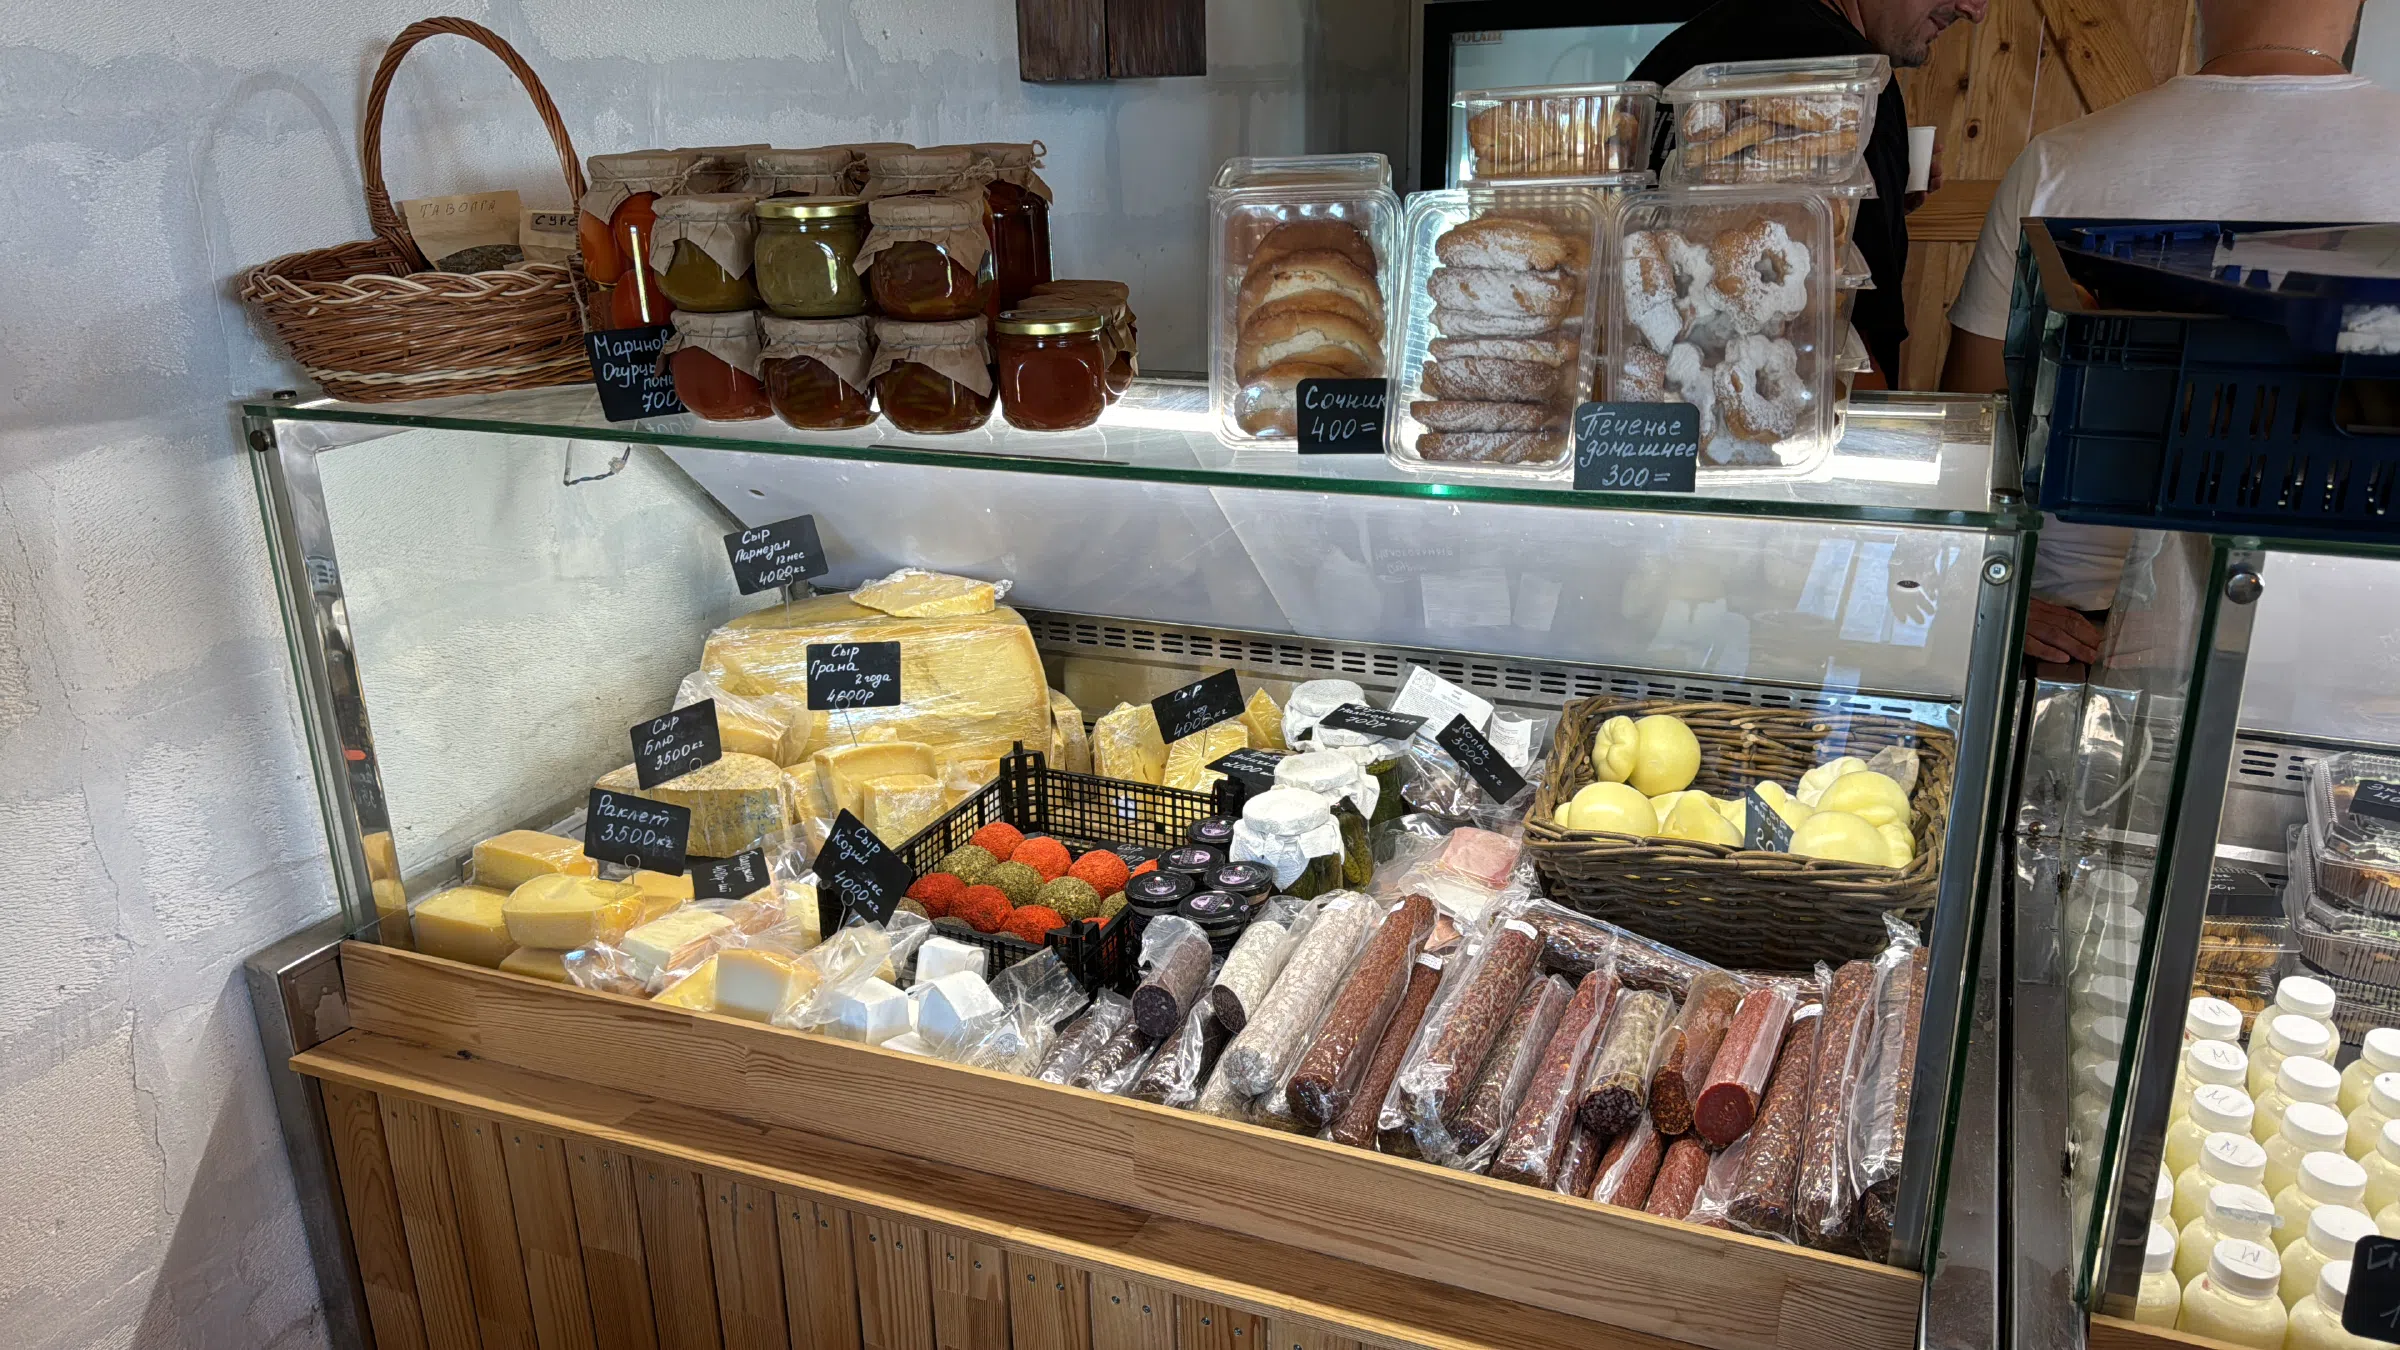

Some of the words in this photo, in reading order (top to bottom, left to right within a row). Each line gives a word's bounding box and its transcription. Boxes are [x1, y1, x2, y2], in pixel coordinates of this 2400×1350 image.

[641, 389, 684, 413] 700
[1576, 405, 1682, 441] Печенье
[1579, 440, 1697, 468] домашнее
[742, 529, 771, 544] Сыр
[831, 643, 860, 662] Сыр
[810, 659, 860, 681] Грана
[1174, 684, 1203, 702] Сыр
[652, 715, 680, 735] Сыр
[643, 734, 675, 756] Блю
[596, 794, 670, 828] Раклет
[855, 827, 881, 857] Сыр
[1755, 827, 1784, 852] 20
